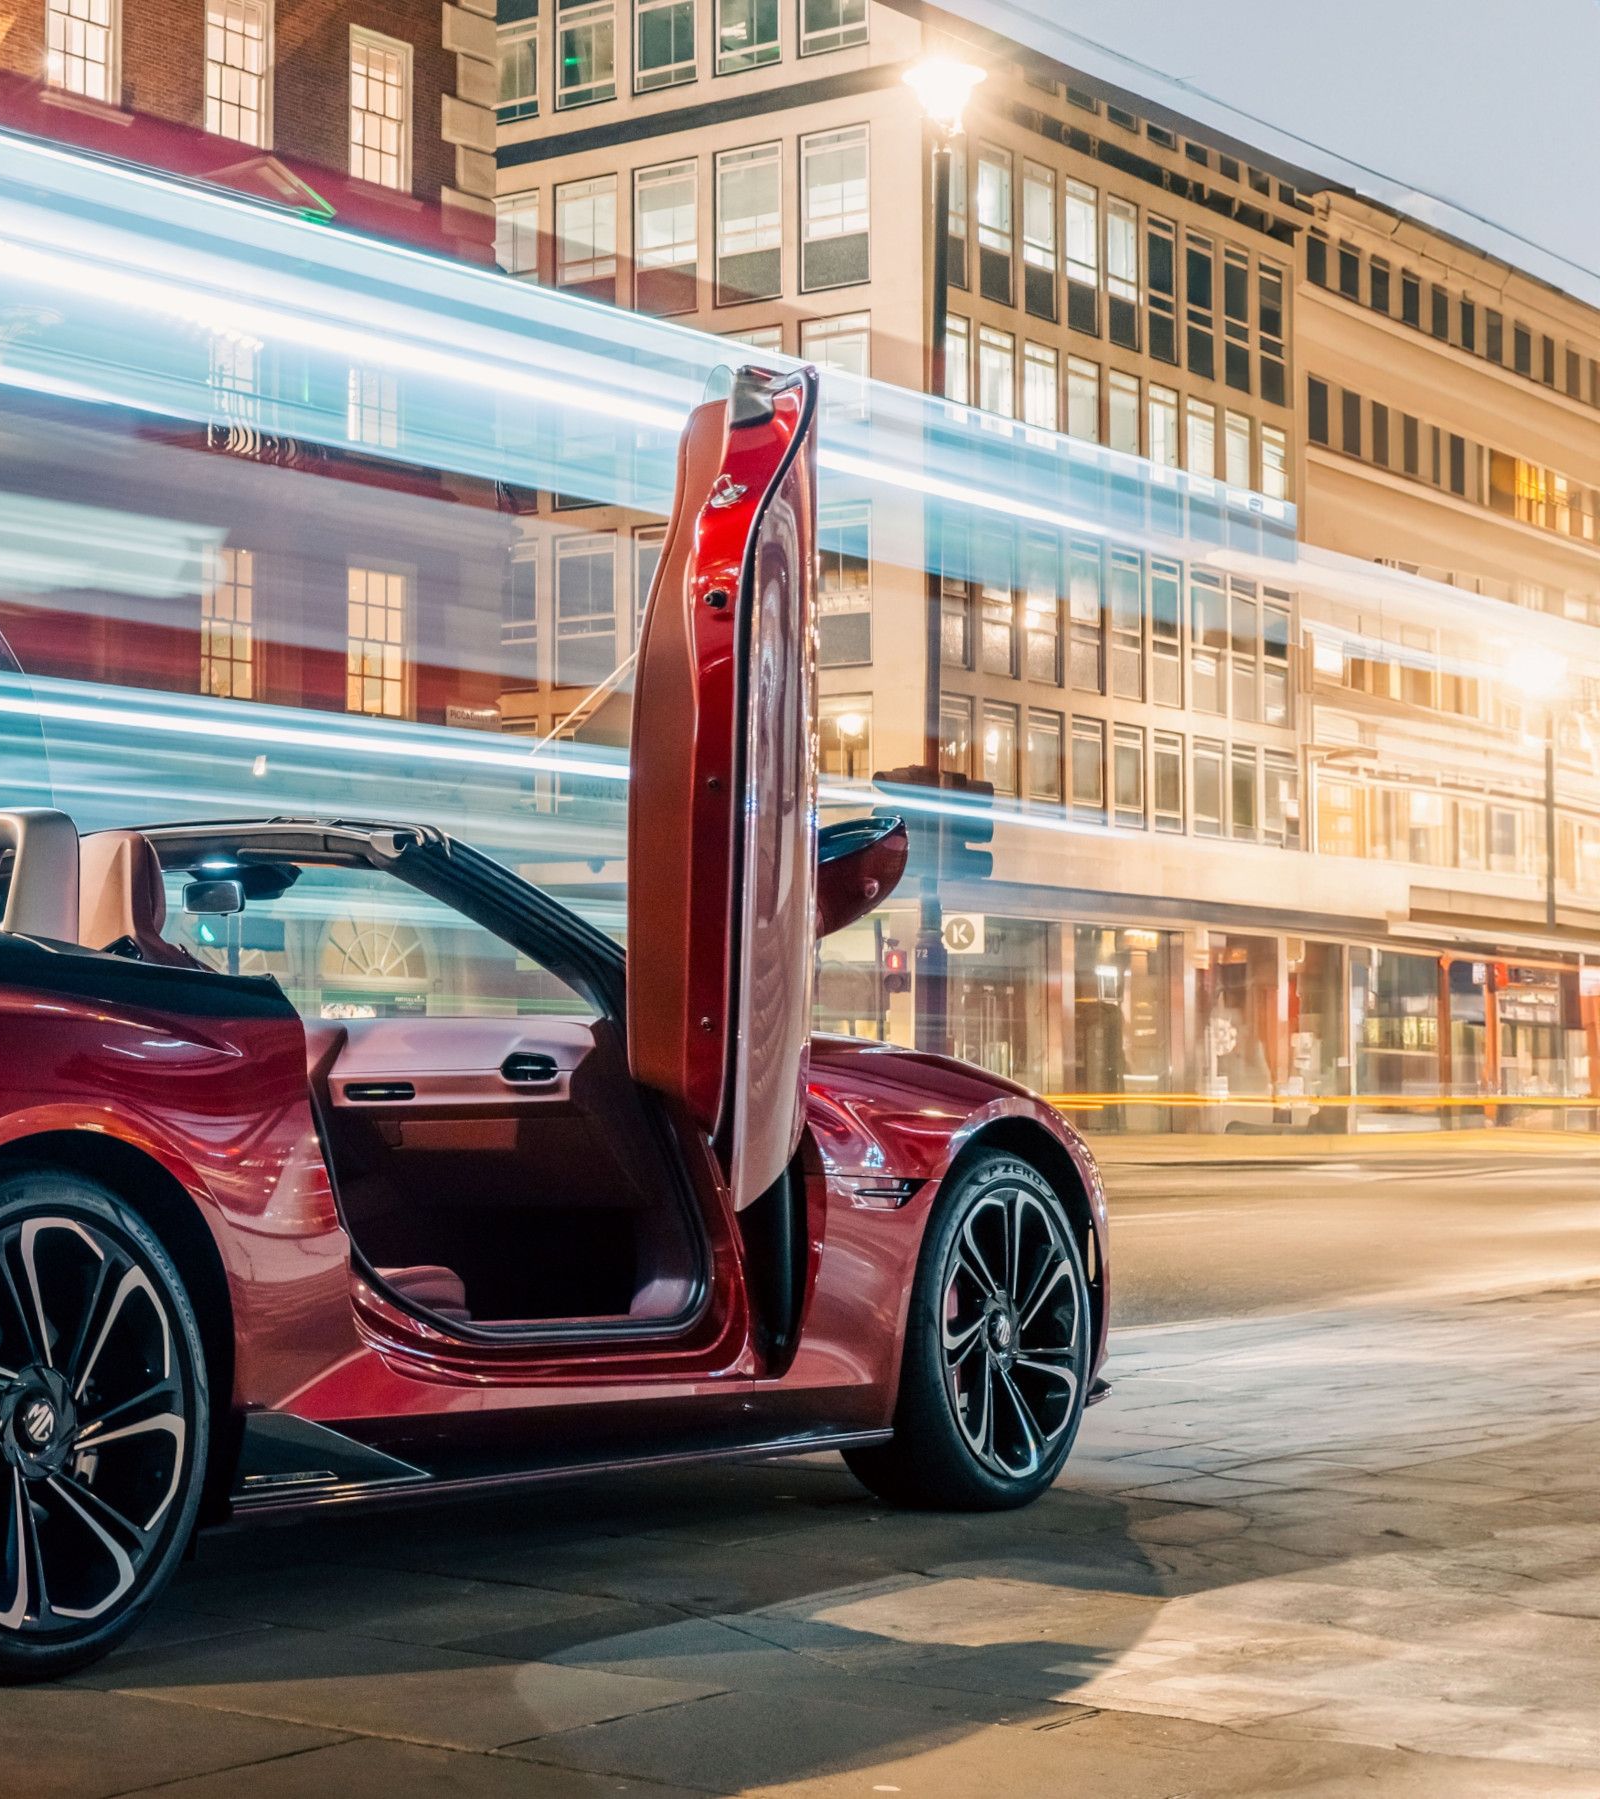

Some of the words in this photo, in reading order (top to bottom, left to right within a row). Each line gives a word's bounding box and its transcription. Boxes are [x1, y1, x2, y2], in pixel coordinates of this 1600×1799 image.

[952, 922, 970, 944] K
[916, 948, 929, 958] 72
[1001, 1163, 1042, 1186] ZERO
[28, 1403, 55, 1442] MG
